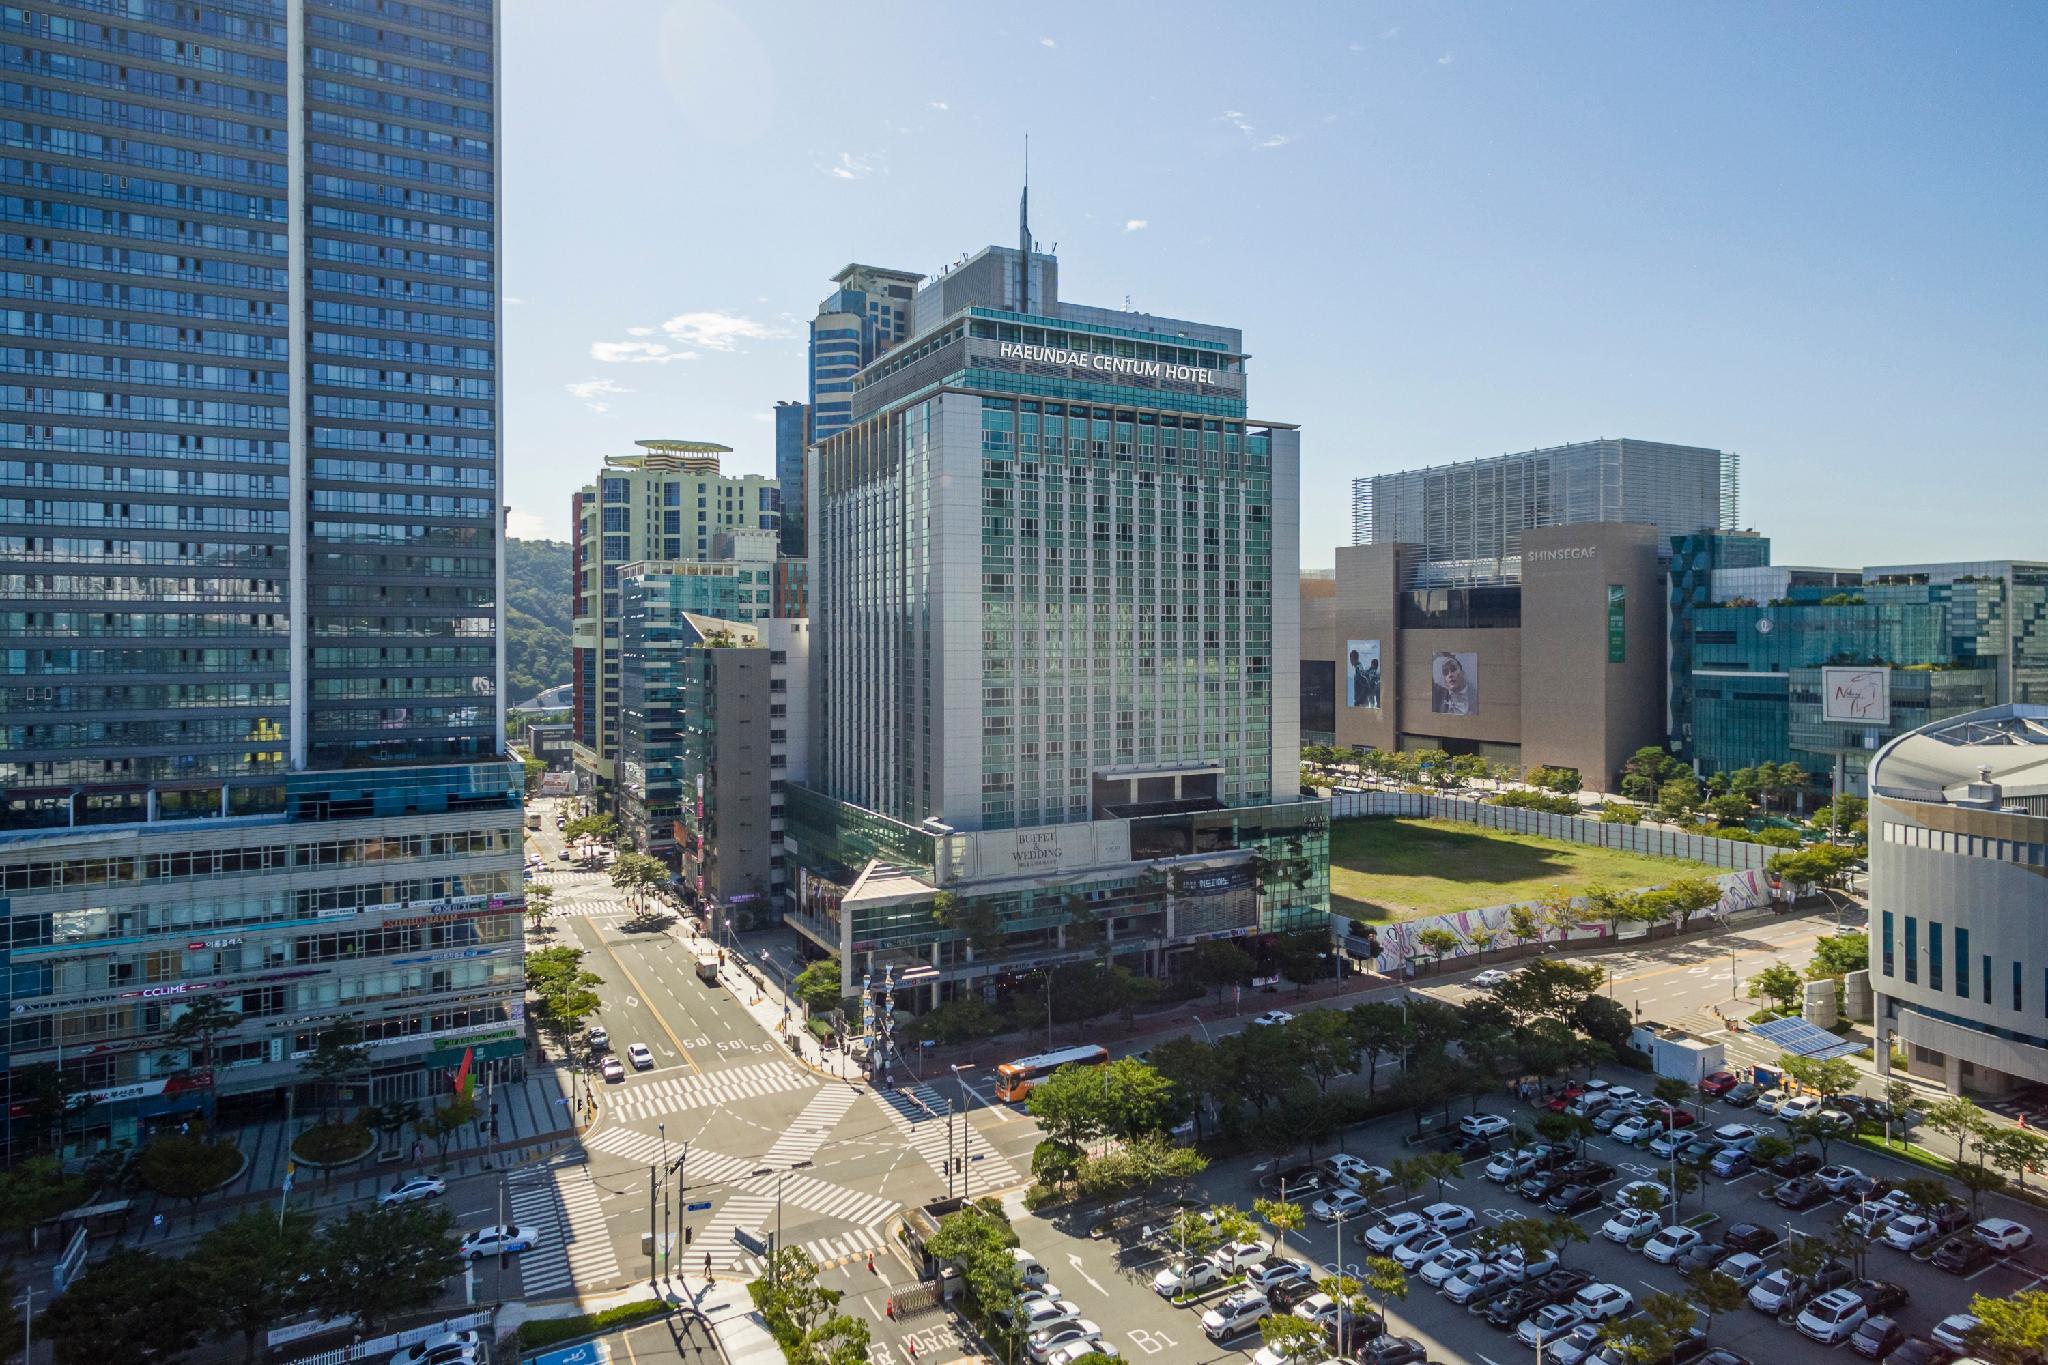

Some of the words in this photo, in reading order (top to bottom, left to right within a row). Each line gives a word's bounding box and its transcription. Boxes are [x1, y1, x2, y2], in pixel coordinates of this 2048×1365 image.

[1000, 342, 1088, 368] HAEUNDAE
[1093, 355, 1160, 378] CENTUM
[1165, 365, 1215, 385] HOTEL
[1527, 546, 1596, 562] SHINSEGAE
[1018, 832, 1055, 844] BUFFET
[1012, 848, 1063, 861] WEDDING
[682, 1037, 708, 1049] 50
[716, 1040, 741, 1051] 50
[749, 1043, 775, 1054] 50
[111, 1087, 144, 1098] 부산은행
[1126, 1329, 1178, 1354] B1
